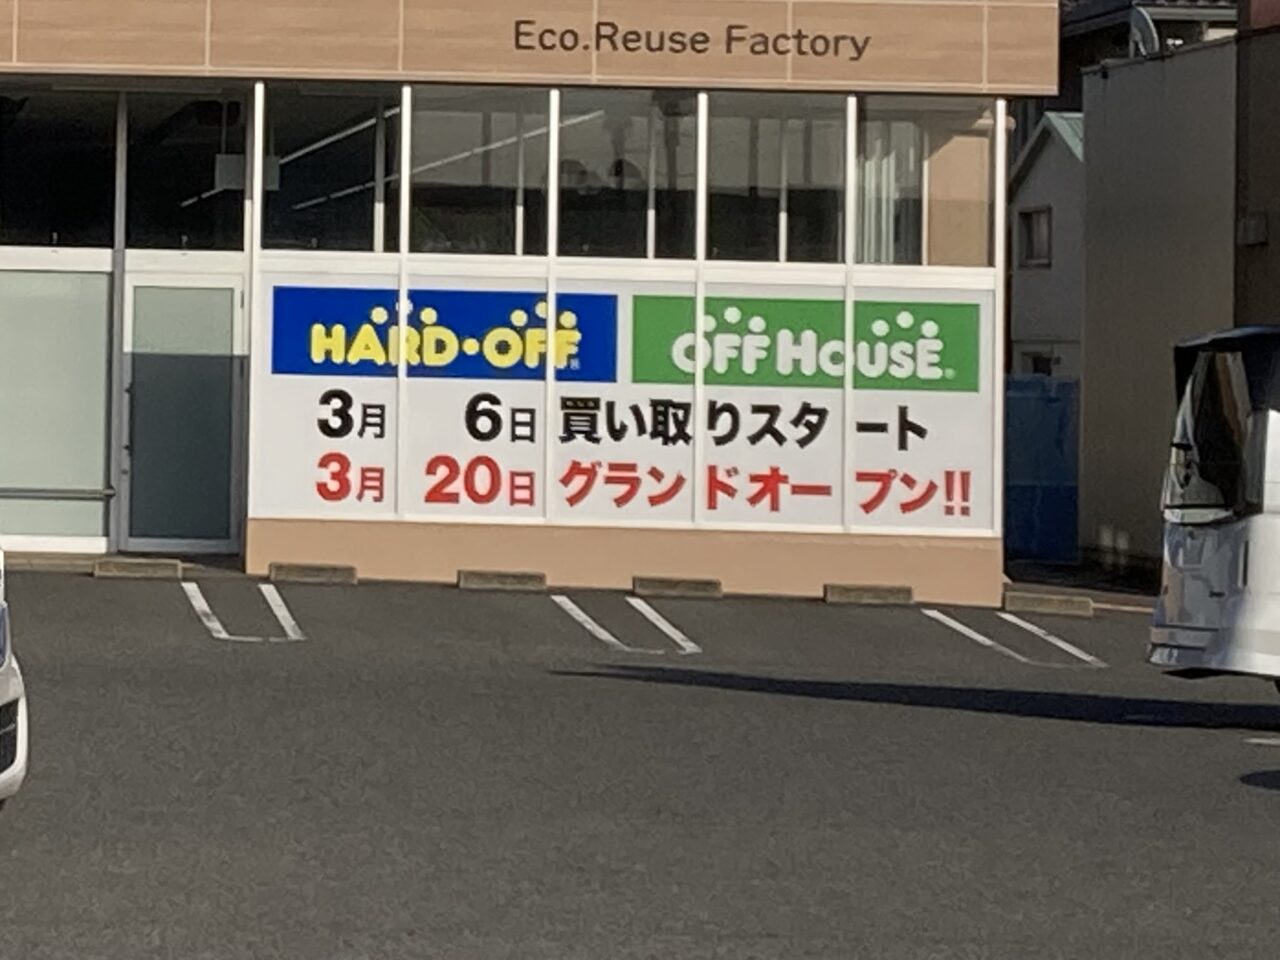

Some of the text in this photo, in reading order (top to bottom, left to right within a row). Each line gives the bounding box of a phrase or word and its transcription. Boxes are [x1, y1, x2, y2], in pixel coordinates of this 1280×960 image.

[725, 24, 872, 61] Factory
[671, 332, 771, 374] OFF
[318, 389, 928, 451] 3月 6日 買い取りスタート
[316, 452, 386, 504] 3月
[424, 455, 535, 506] 20日
